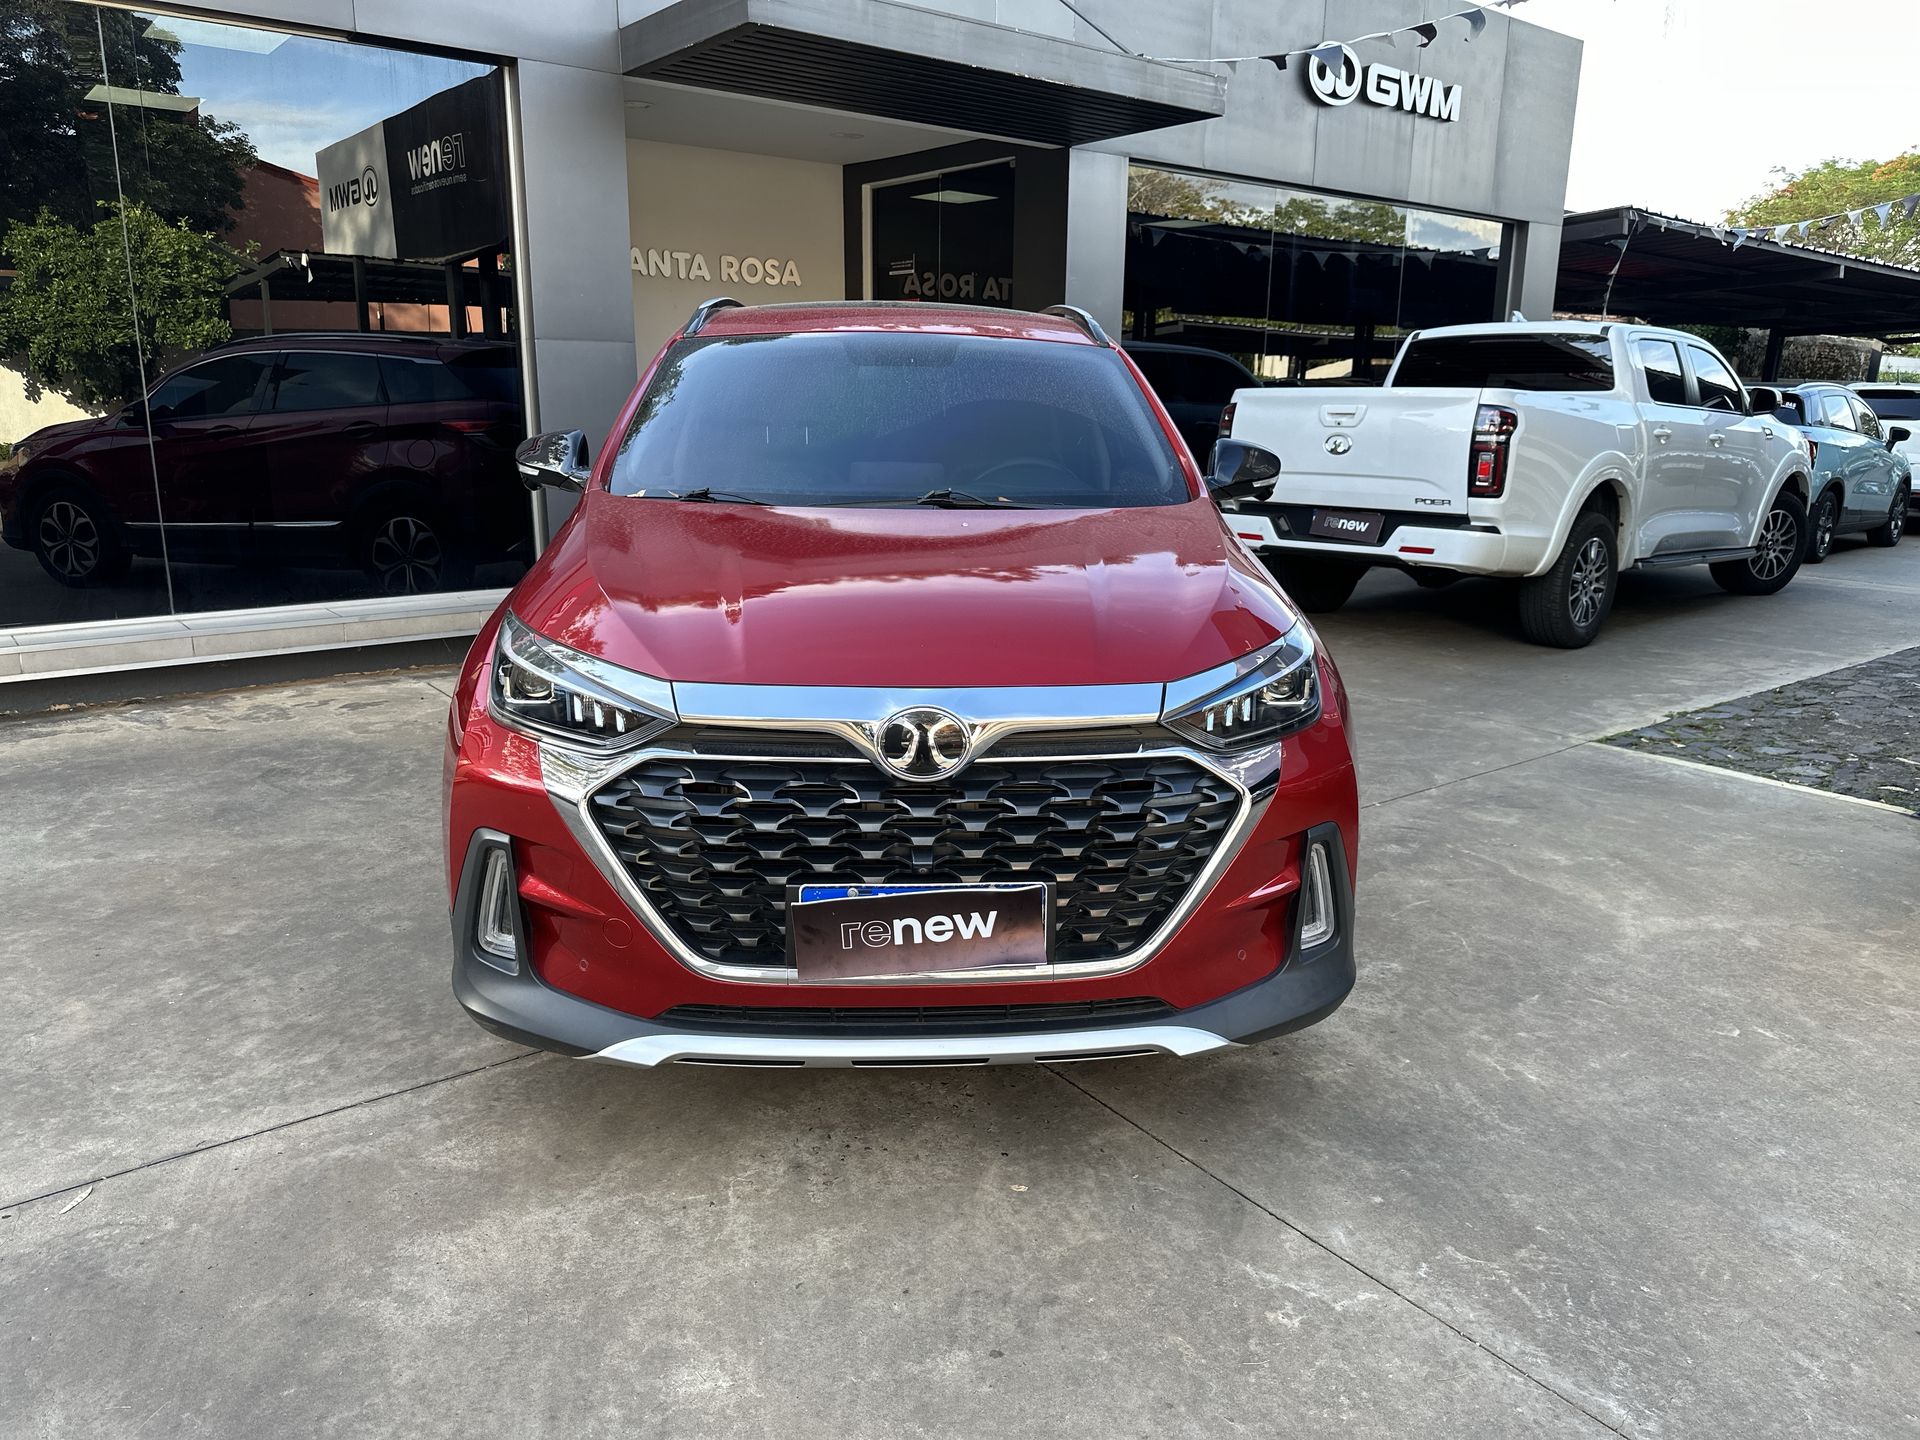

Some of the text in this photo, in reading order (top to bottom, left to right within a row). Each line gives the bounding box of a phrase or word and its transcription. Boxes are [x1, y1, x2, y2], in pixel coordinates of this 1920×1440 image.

[1366, 62, 1462, 122] GWM
[720, 255, 802, 286] ROSA
[1323, 516, 1370, 532] renew
[840, 910, 998, 950] renew
